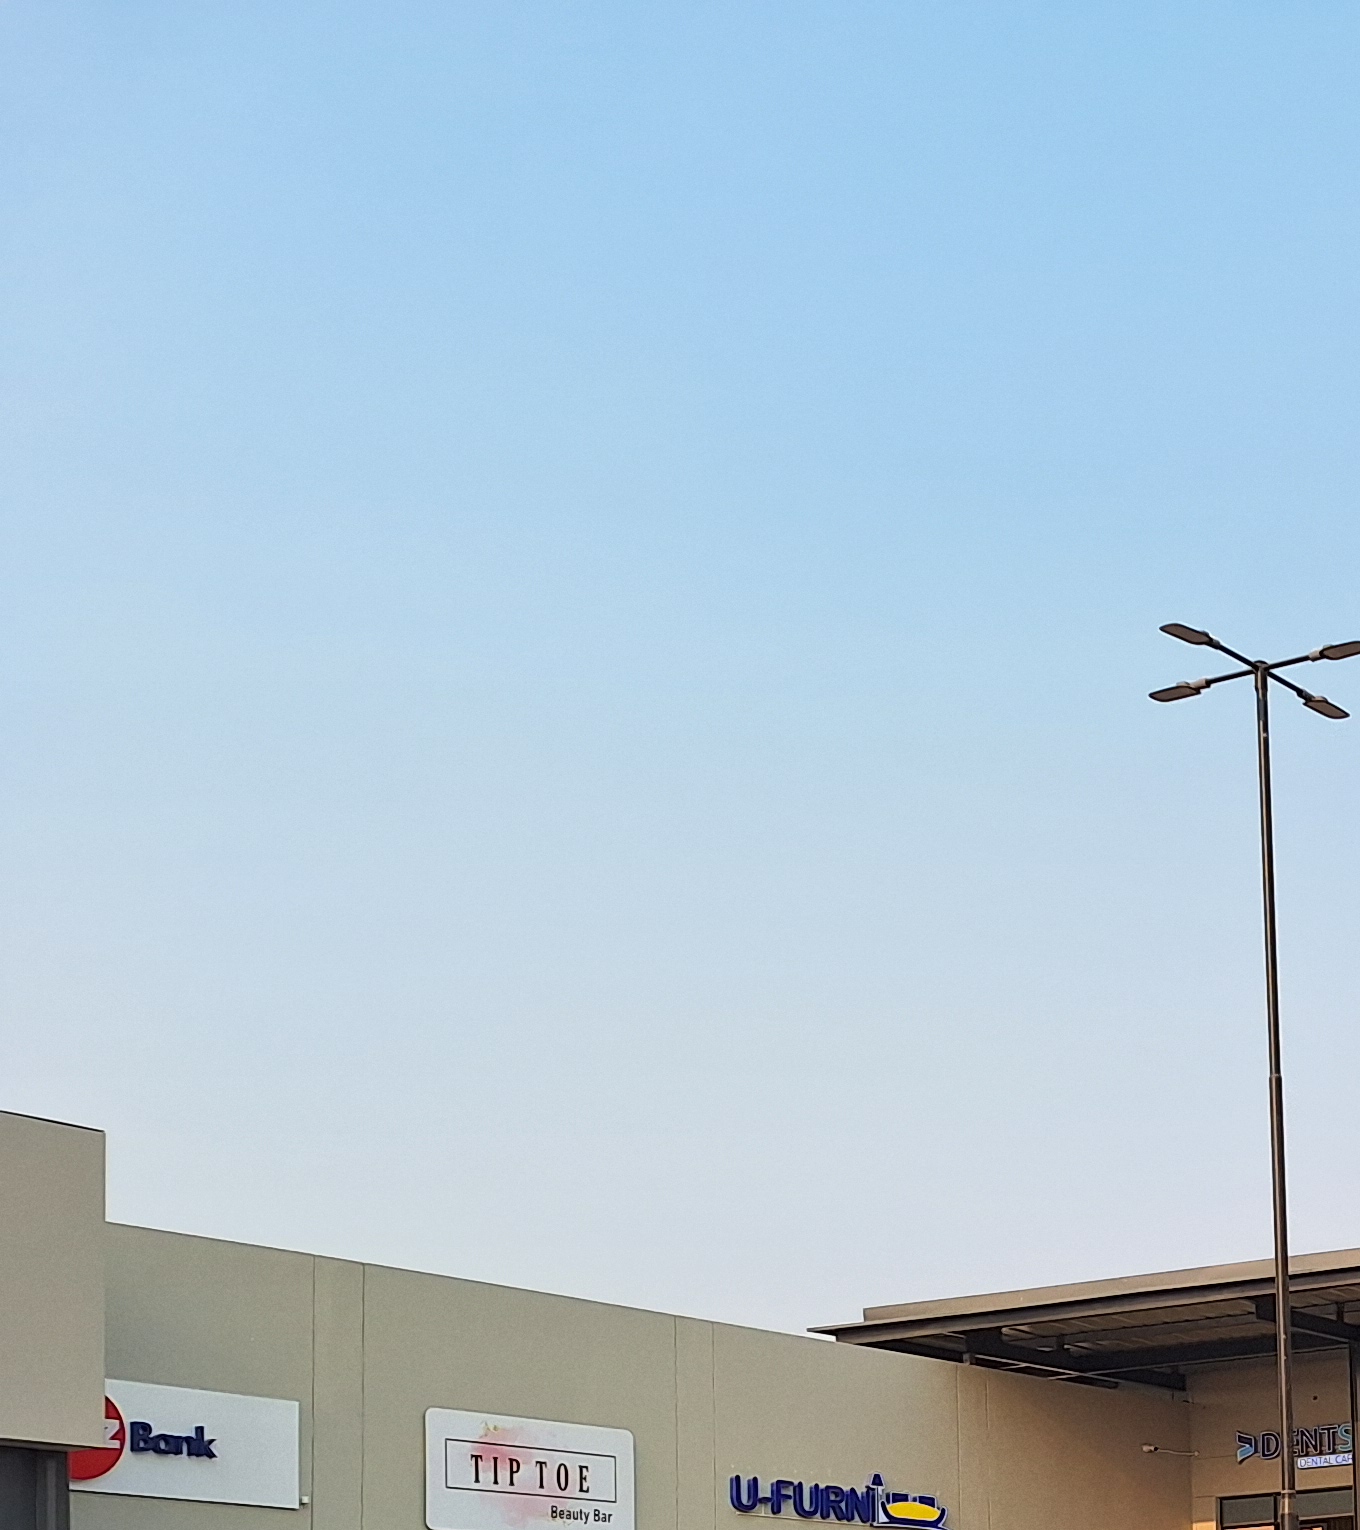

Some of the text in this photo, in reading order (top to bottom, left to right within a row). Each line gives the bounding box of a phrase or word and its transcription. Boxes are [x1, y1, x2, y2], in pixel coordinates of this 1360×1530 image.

[129, 1420, 218, 1460] Bank
[470, 1453, 590, 1494] TIP TOE
[1299, 1455, 1333, 1468] DENTAL
[550, 1505, 613, 1525] Beauty Bar
